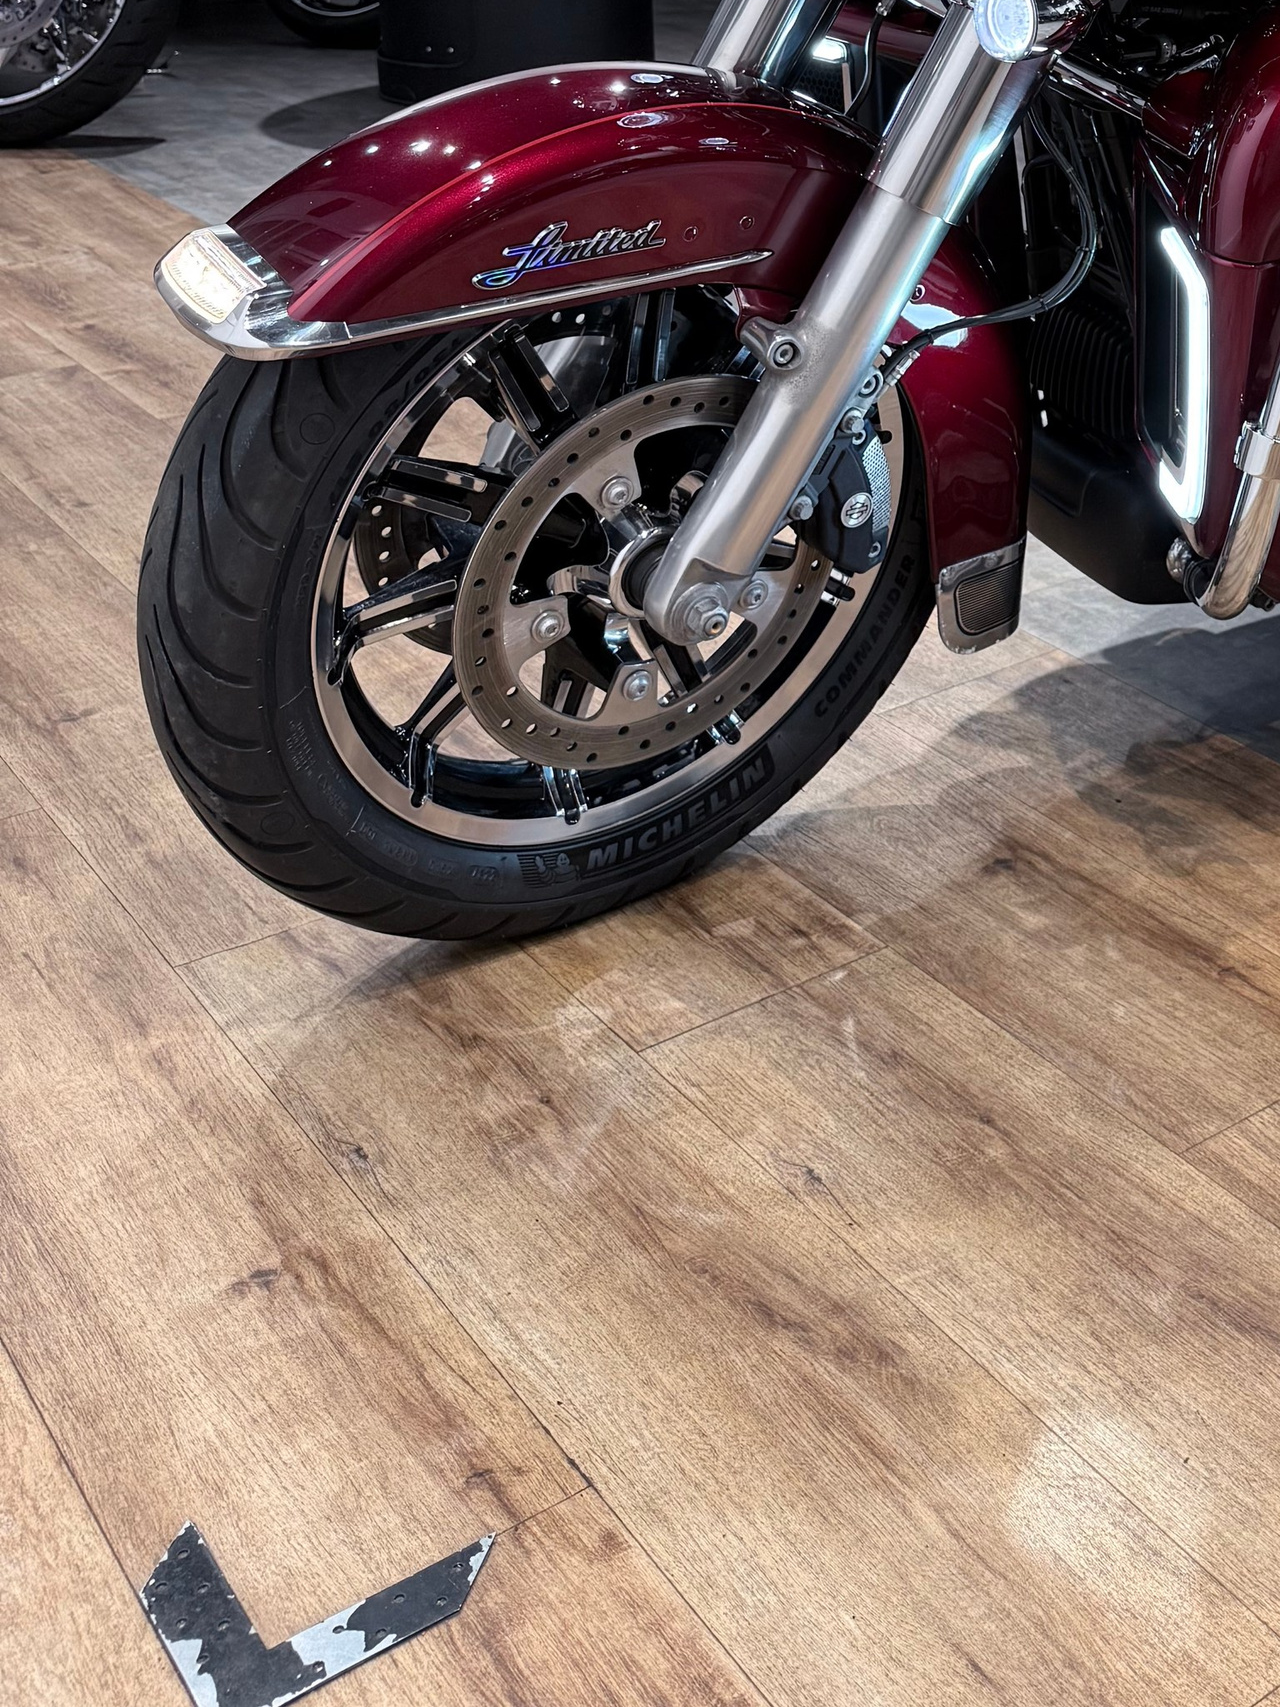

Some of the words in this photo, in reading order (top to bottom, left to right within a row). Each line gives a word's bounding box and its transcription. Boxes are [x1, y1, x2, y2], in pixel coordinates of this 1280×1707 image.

[472, 220, 666, 290] Limited
[814, 553, 917, 718] COMMANDER
[587, 754, 767, 871] MICHELIN
